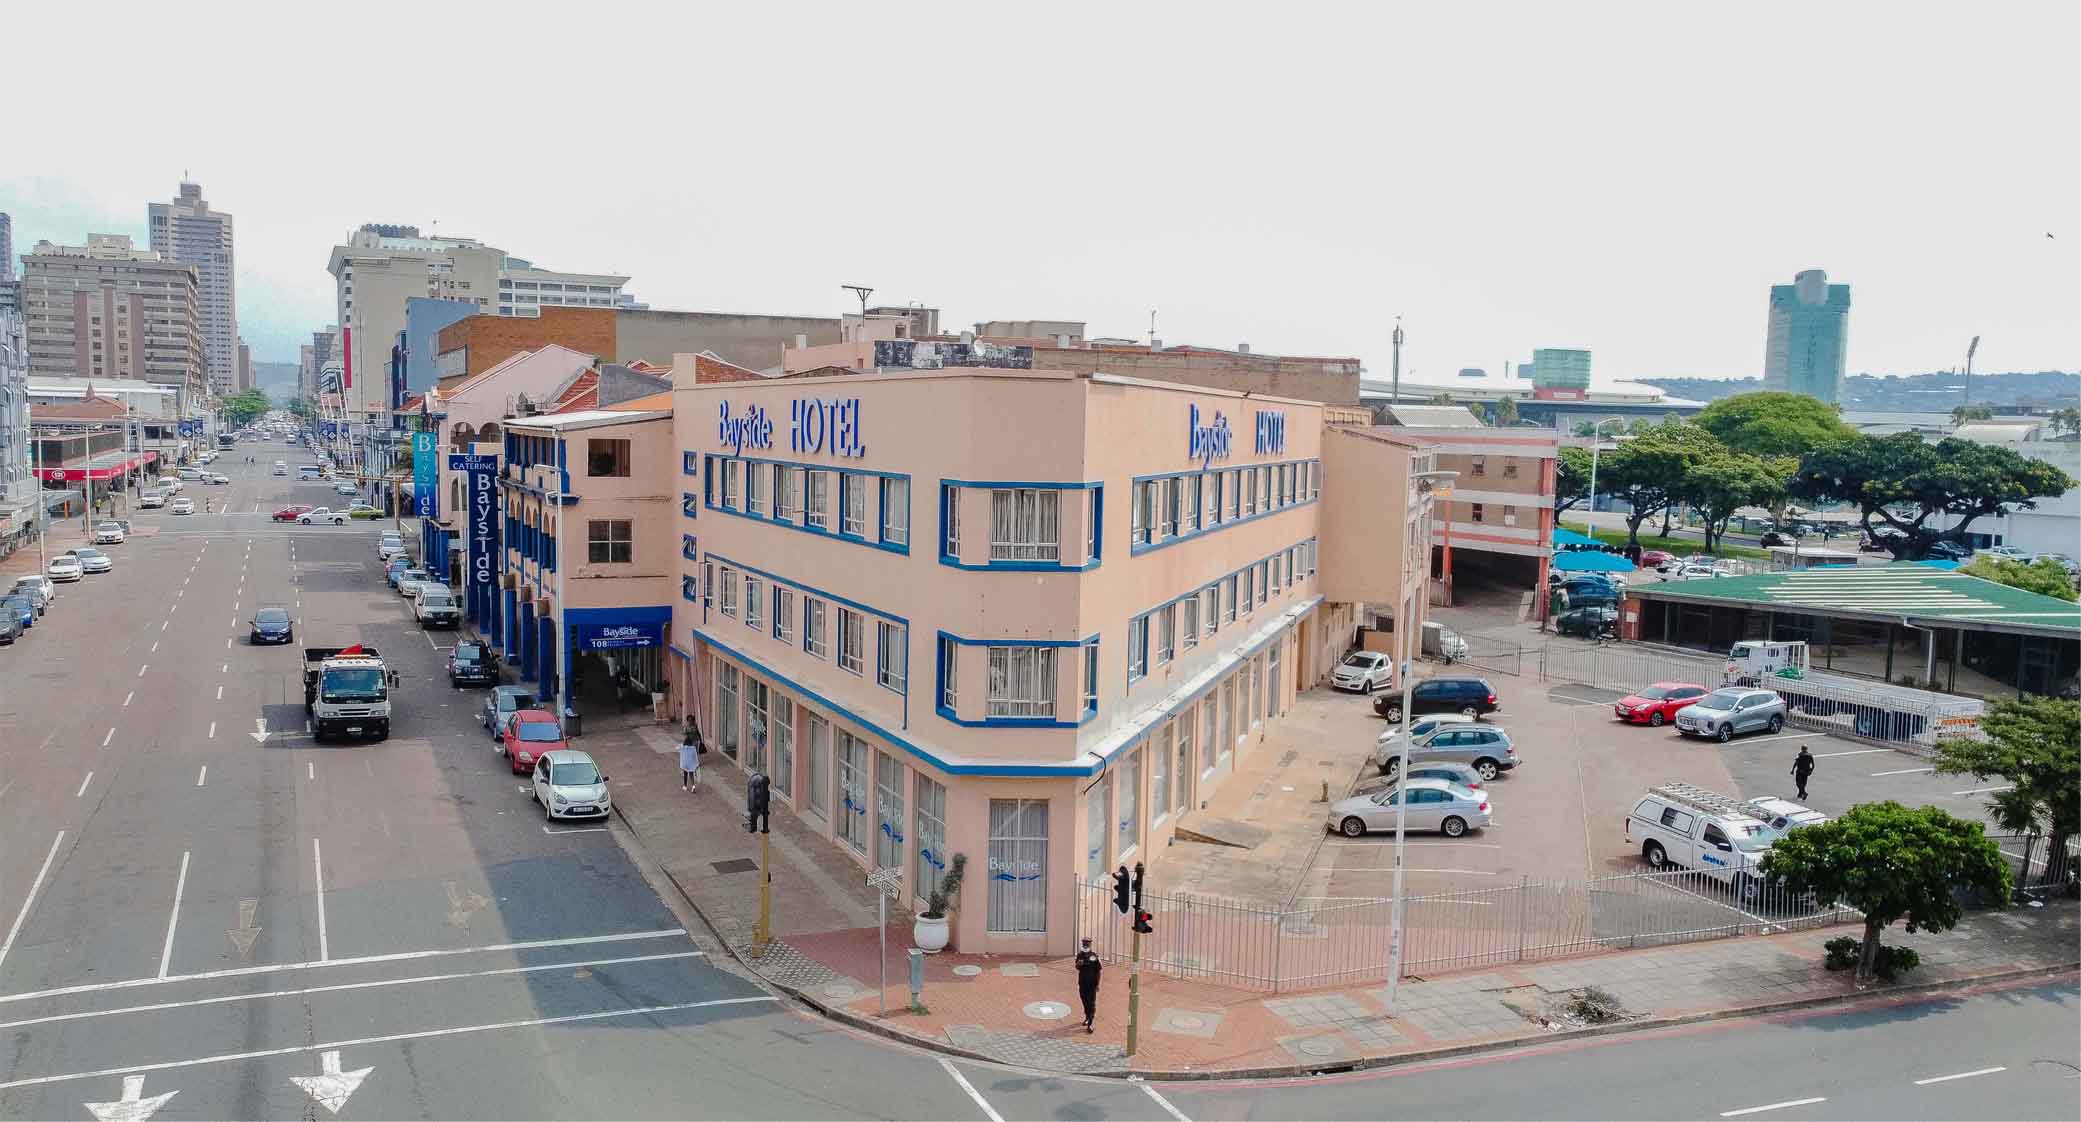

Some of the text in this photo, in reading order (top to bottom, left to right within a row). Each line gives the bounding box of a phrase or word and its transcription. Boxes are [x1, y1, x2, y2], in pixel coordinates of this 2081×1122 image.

[719, 398, 866, 458] Bayside HOTEL
[452, 462, 495, 470] CATERING
[475, 473, 492, 582] Bayside
[603, 626, 639, 638] Bayside
[591, 640, 608, 648] 108
